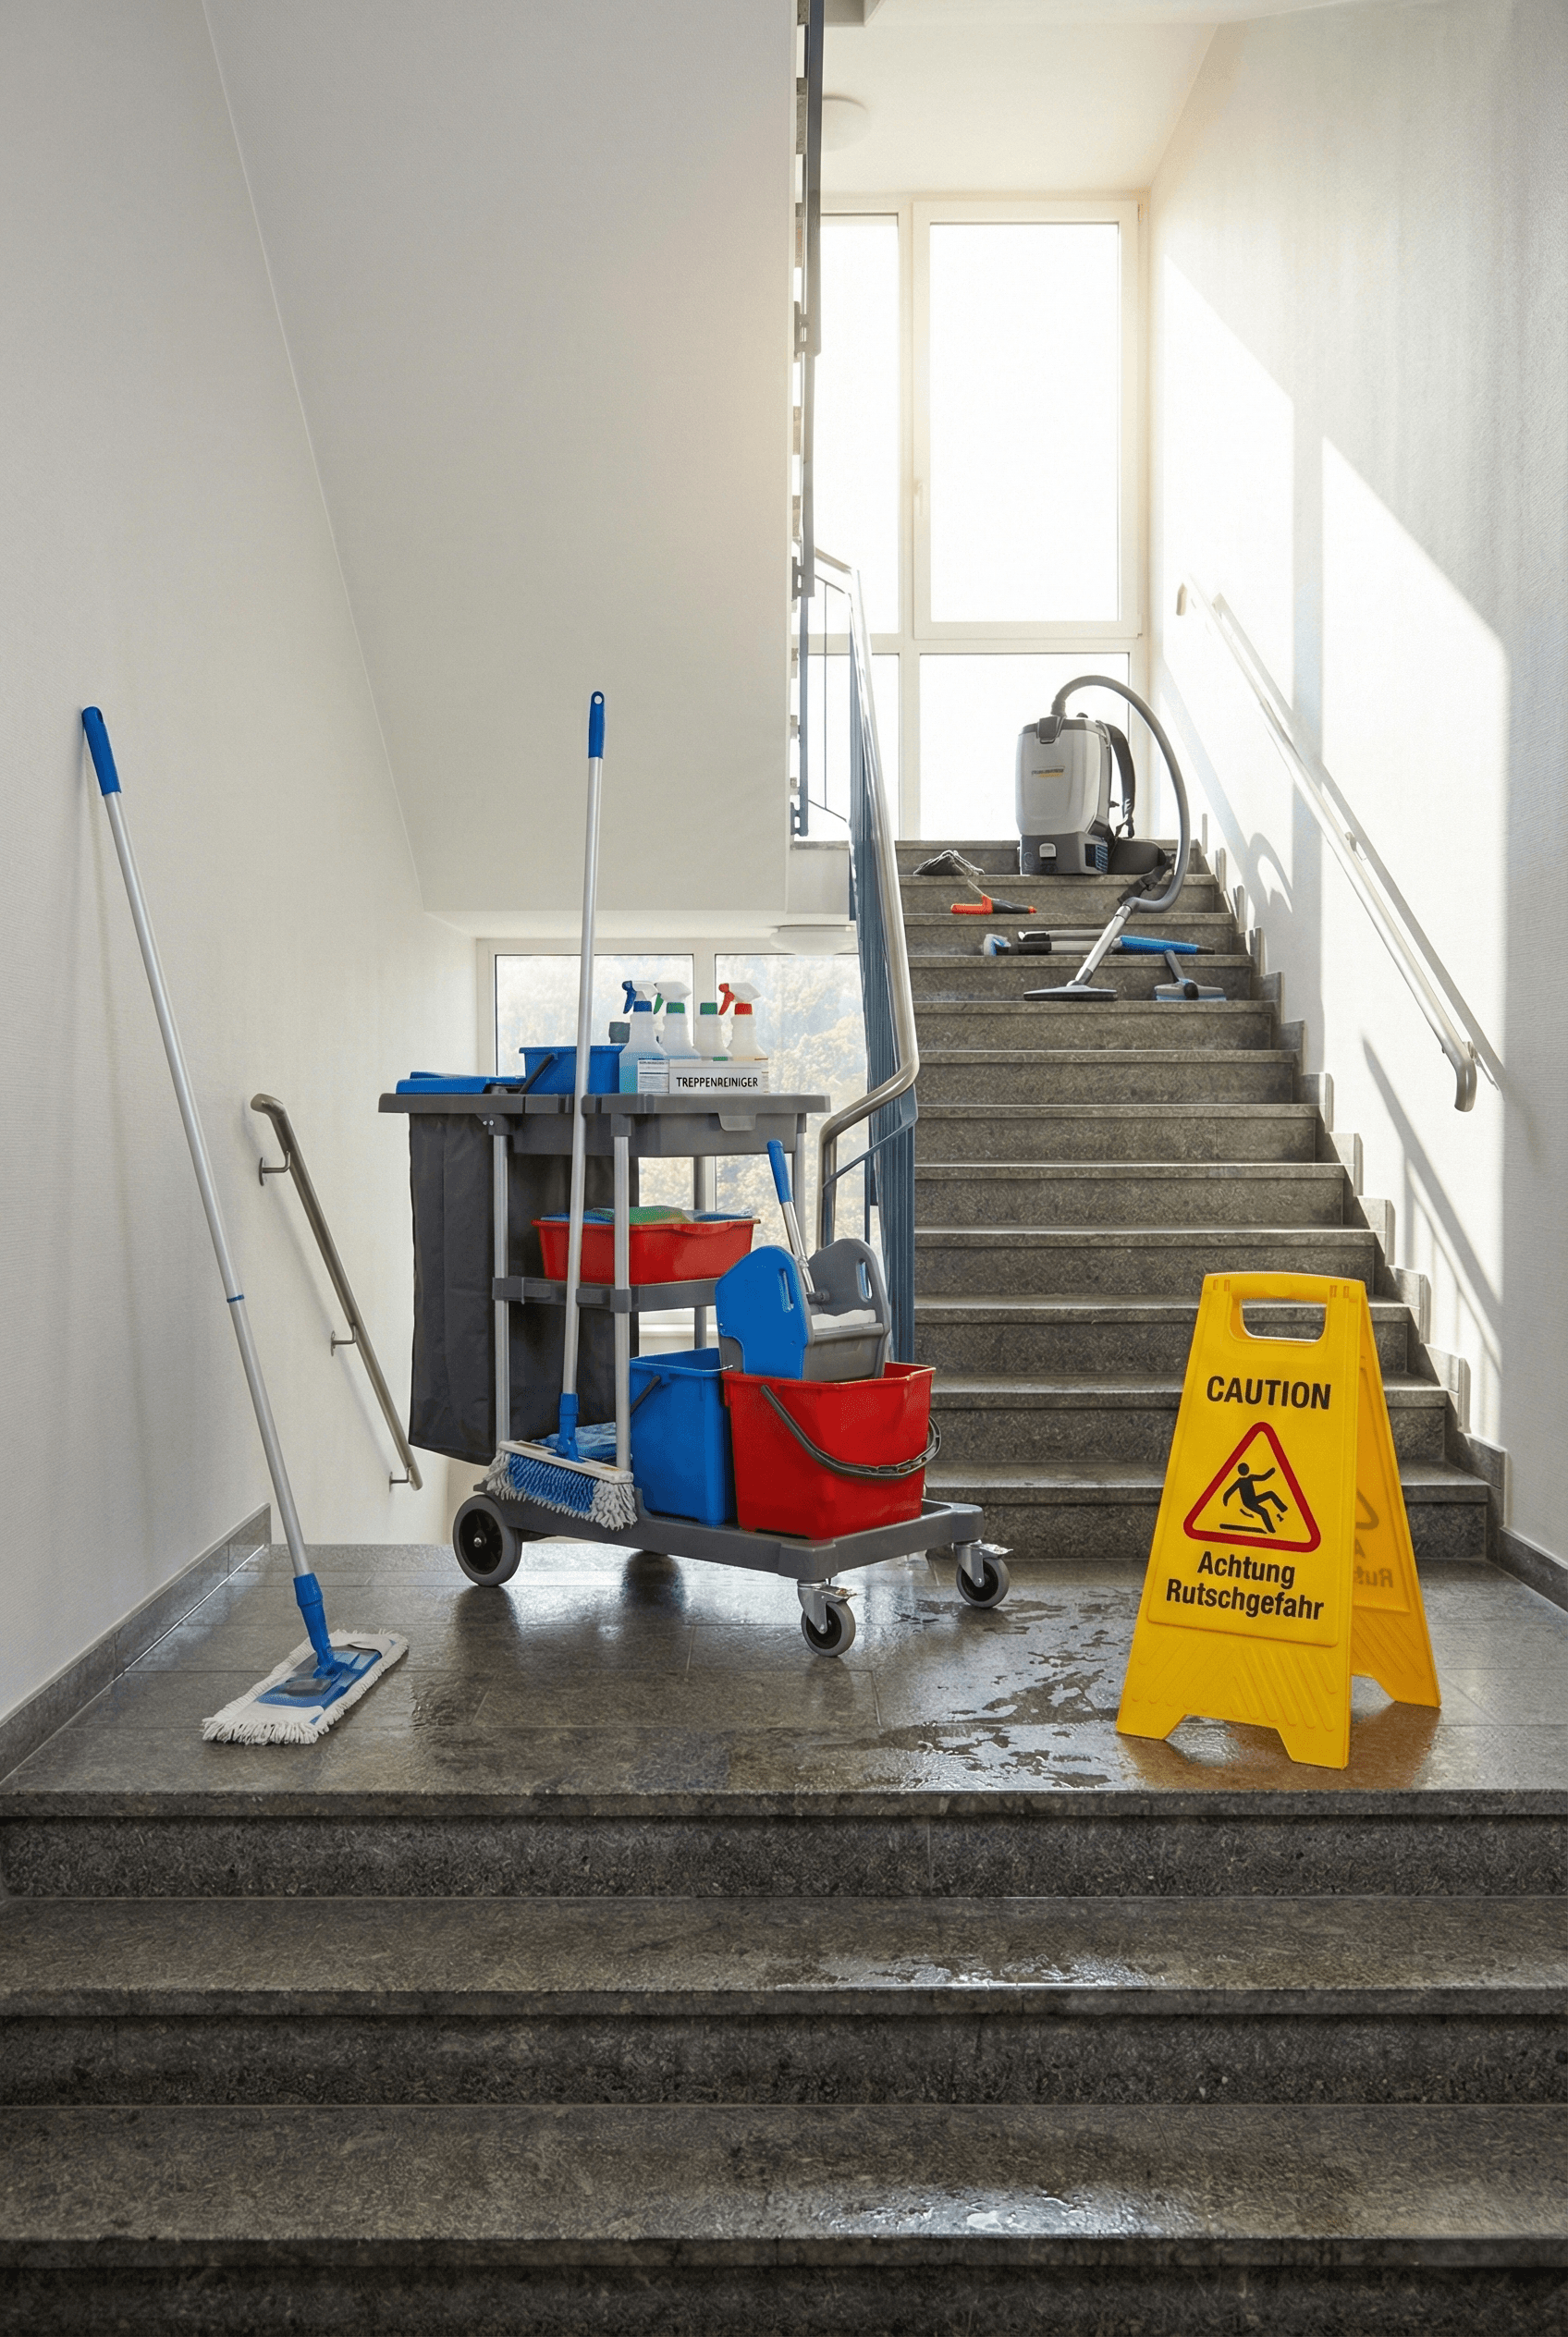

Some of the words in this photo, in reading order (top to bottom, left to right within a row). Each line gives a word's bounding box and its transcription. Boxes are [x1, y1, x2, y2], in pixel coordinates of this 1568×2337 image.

[676, 1077, 758, 1087] TREPPENREINIGER
[1207, 1376, 1331, 1410] CAUTION
[1196, 1550, 1296, 1590] Achtung
[1166, 1578, 1325, 1621] Rutschgefahr
